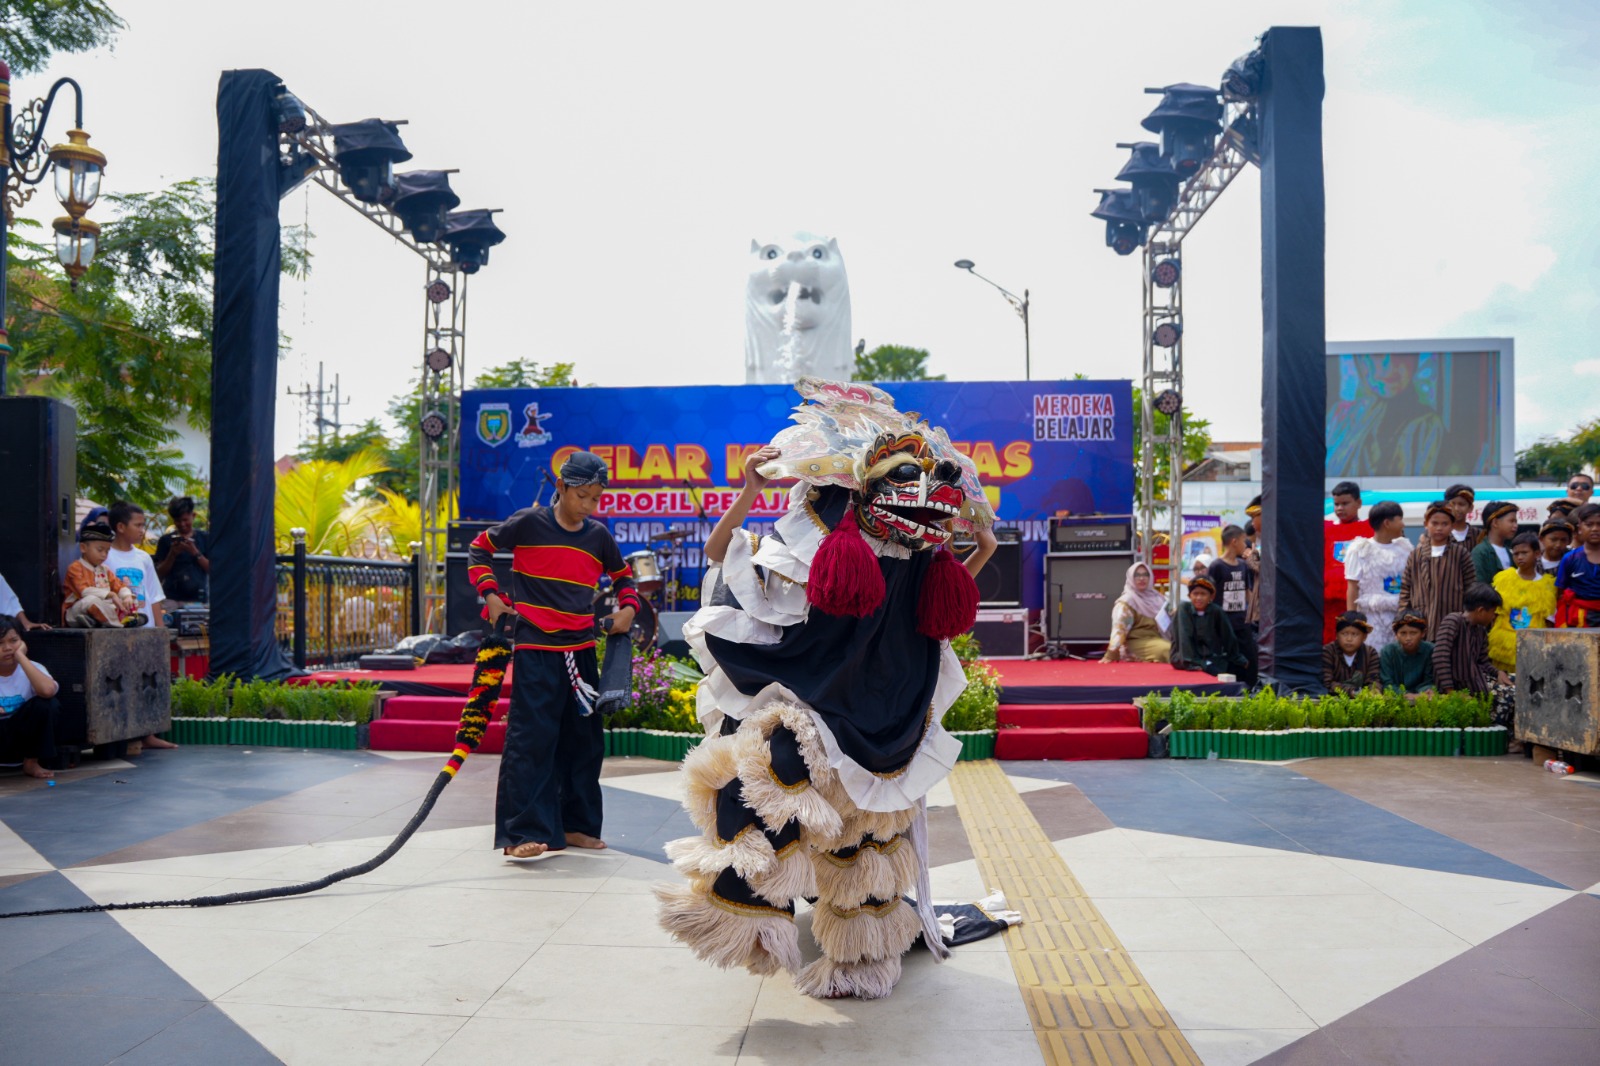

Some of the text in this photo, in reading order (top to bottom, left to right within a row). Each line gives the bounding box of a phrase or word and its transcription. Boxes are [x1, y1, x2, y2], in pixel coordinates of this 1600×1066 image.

[1035, 395, 1113, 416] MERDEKA
[1035, 418, 1113, 440] BELAJAR
[598, 491, 693, 512] PROFIL
[614, 522, 665, 543] SMP
